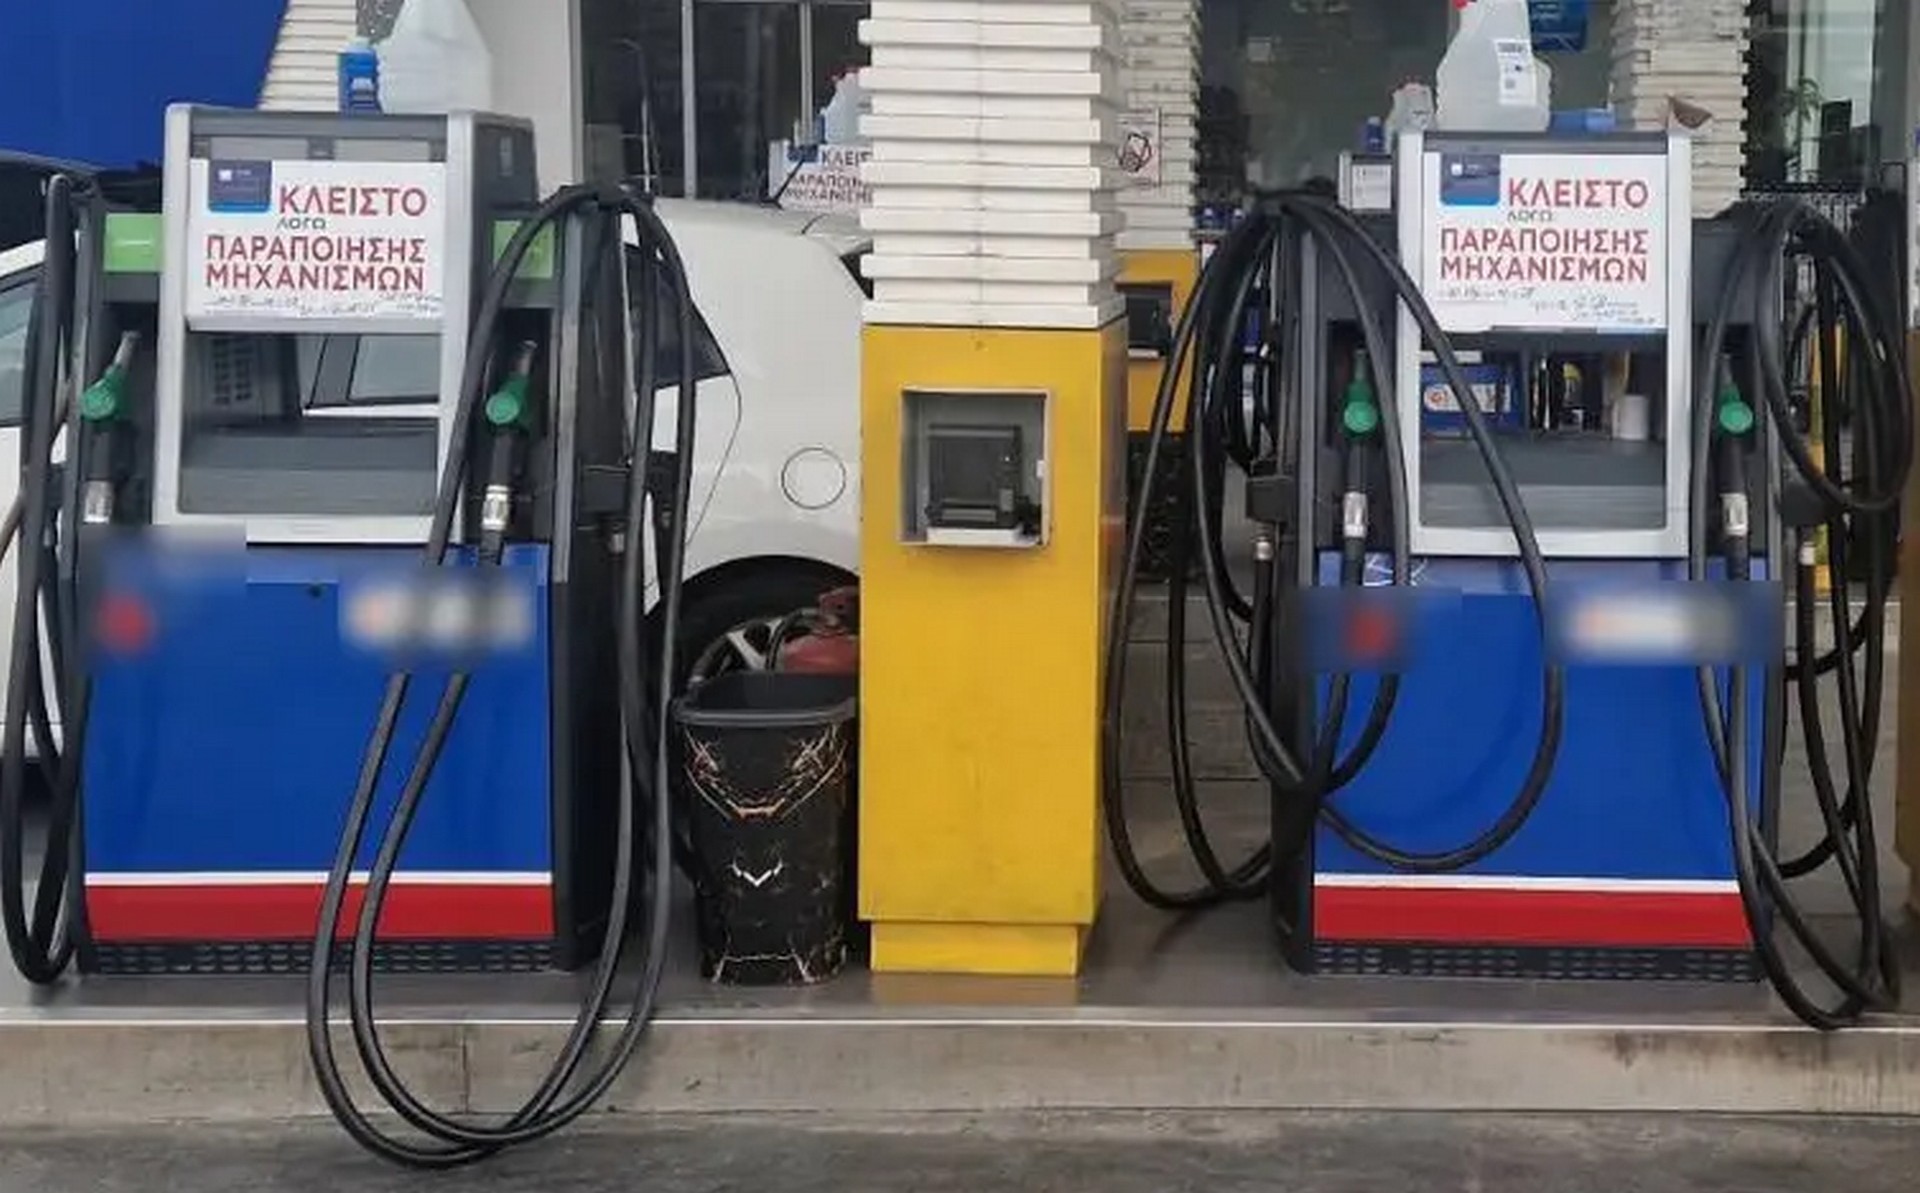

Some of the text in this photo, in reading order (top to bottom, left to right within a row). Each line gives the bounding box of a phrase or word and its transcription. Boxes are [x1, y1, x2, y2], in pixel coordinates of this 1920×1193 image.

[280, 186, 427, 216] ΚΛΕΙΣΤΟ
[1508, 178, 1649, 208] ΚΛΕΙΣΤΟ
[206, 235, 426, 263] ΠΑΡΑΠΟΙΗΣΗΣ
[1440, 228, 1649, 255] ΠΑΡΑΠΟΙΗΣΗΣ
[206, 264, 424, 291] ΜΗΧΑΝΙΣΜΩΝ
[1440, 256, 1648, 282] ΜΗΧΑΝΙΣΜΩΝ
